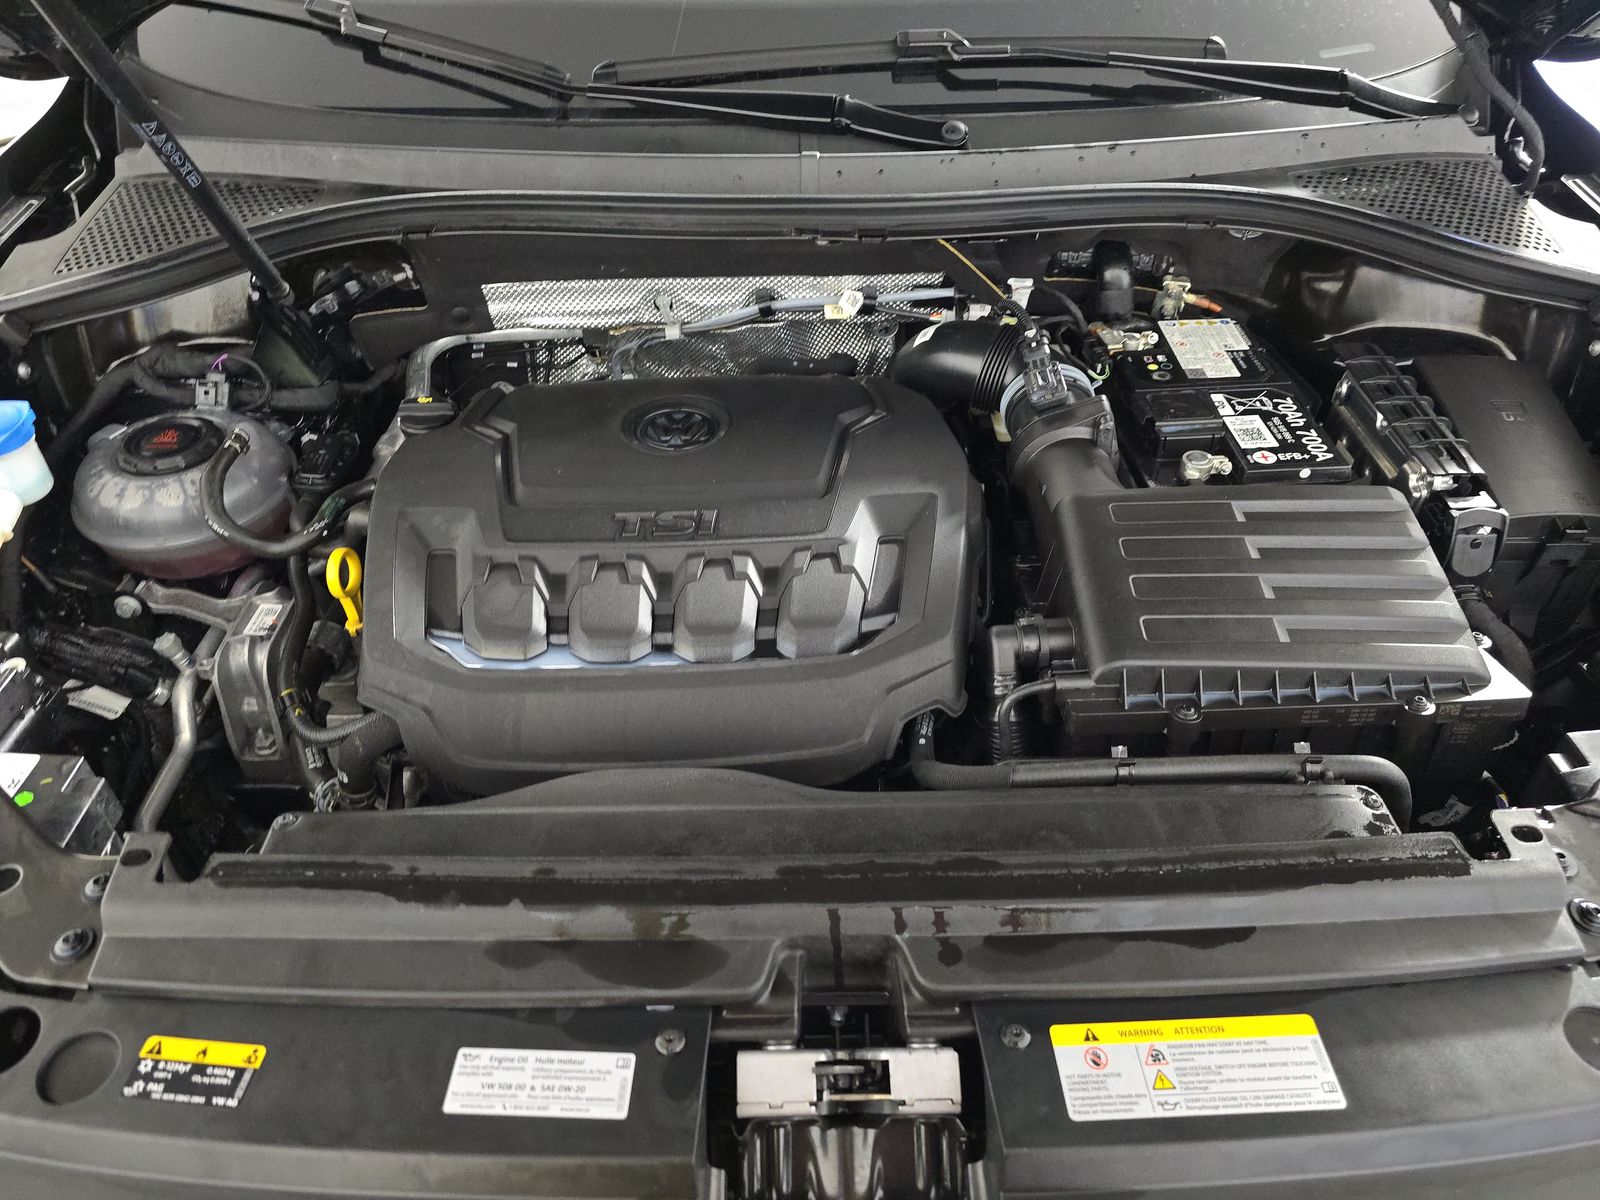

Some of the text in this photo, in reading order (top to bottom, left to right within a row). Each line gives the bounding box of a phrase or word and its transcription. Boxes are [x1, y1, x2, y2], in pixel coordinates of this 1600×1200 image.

[1273, 397, 1307, 427] 70Ah
[1296, 428, 1335, 462] 700A
[613, 508, 719, 538] TSI
[1117, 1024, 1226, 1038] WARNING ATTENTION
[489, 1055, 516, 1064] Engine
